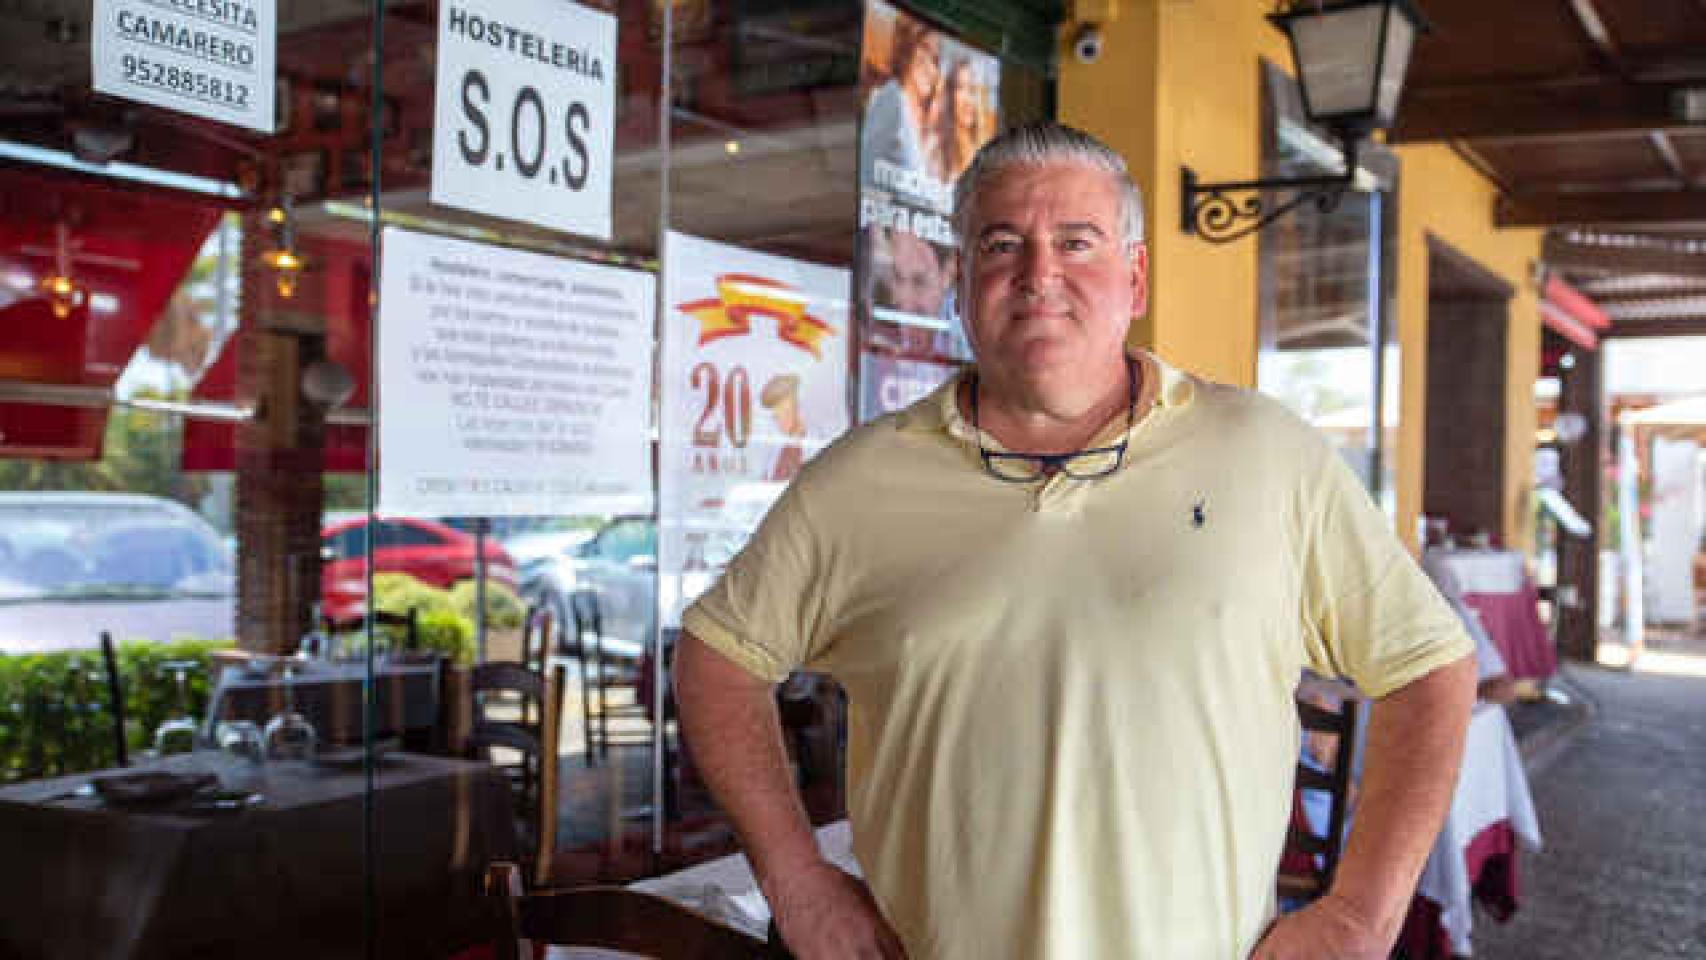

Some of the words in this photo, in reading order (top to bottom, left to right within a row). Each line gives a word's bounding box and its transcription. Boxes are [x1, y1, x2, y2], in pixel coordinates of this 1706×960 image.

[117, 10, 254, 65] CAMARERO
[449, 7, 603, 80] HOSTELERÍA
[122, 54, 248, 104] 952885812
[458, 69, 590, 191] S.O.S
[690, 360, 751, 448] 20
